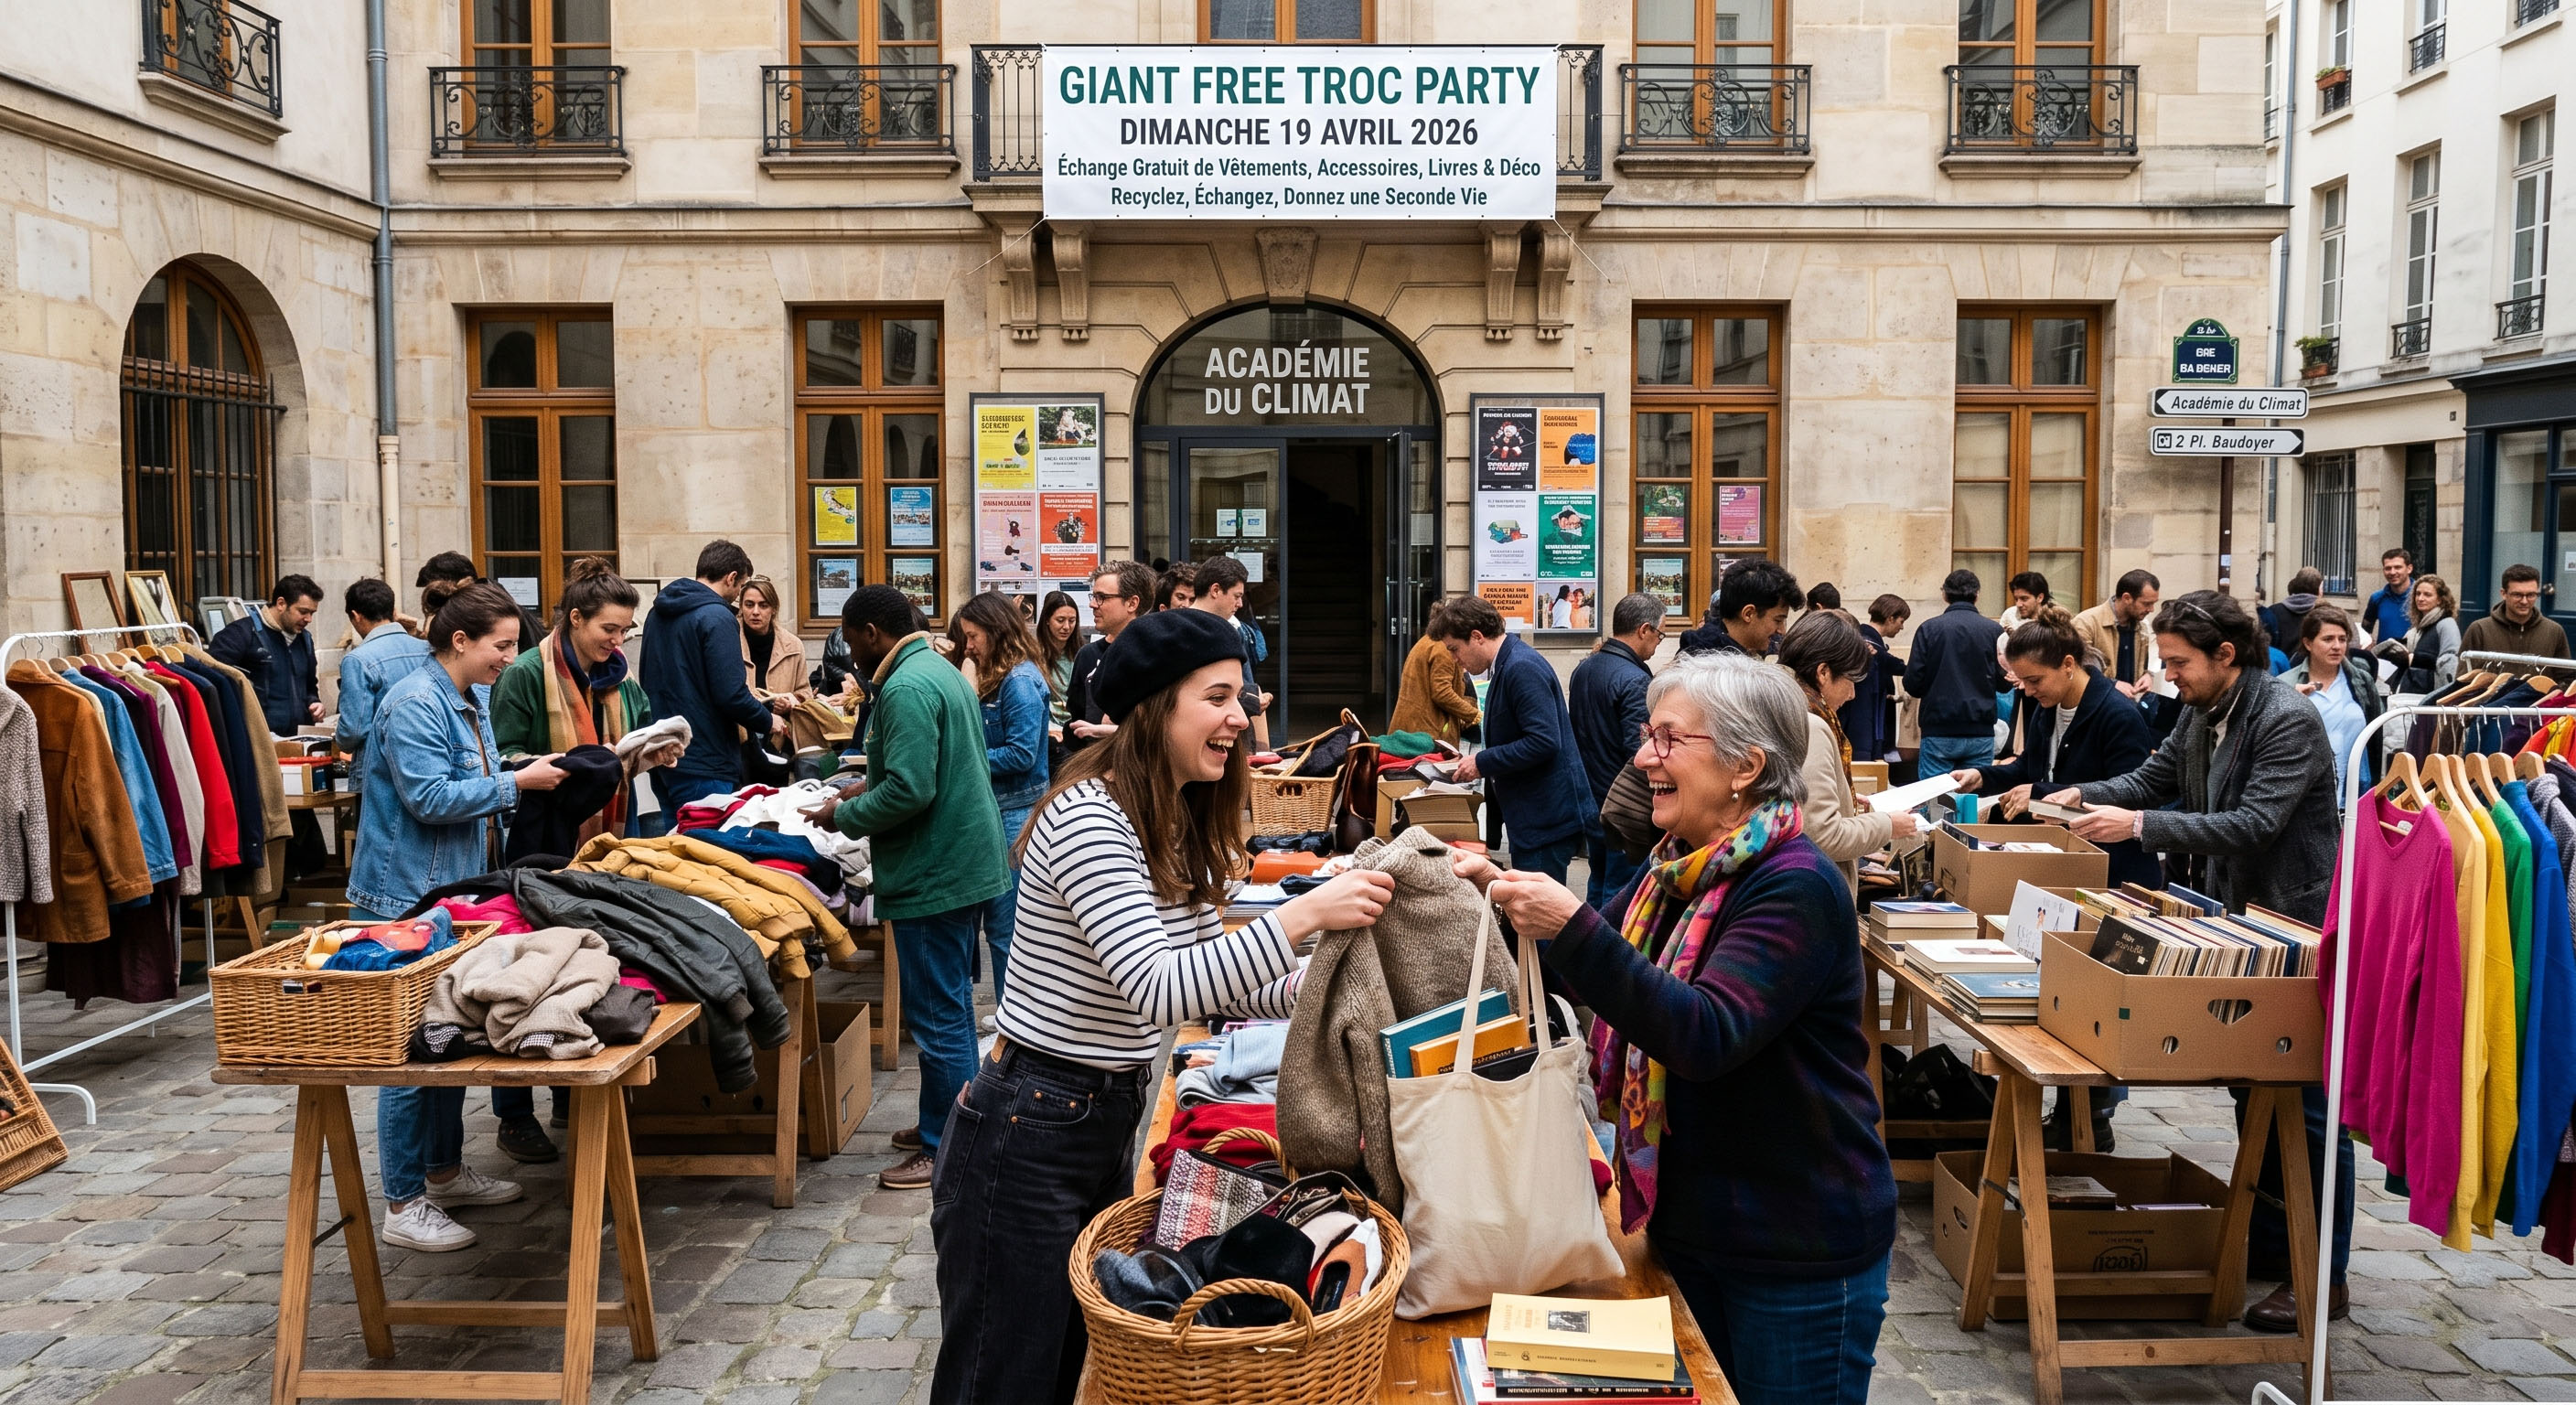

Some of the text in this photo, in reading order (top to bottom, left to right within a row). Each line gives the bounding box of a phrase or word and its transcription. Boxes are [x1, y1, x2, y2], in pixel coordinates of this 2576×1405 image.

[1060, 66, 1540, 104] GIANT FREE TROC PARTY
[1122, 118, 1477, 145] DIMANCHE 19 AVRIL 2026
[1058, 156, 1540, 180] Échange Gratuit de Vêtements, Accessoires, Livres & Déco
[1112, 185, 1487, 209] Recyclez, Échangez, Donnez une Seconde Vie
[1205, 339, 1369, 378] ACADÉMIE
[1206, 383, 1369, 414] DU CLIMAT
[2171, 396, 2302, 411] Académie du Climat
[2175, 434, 2275, 451] 2 Pl. Baudoyer
